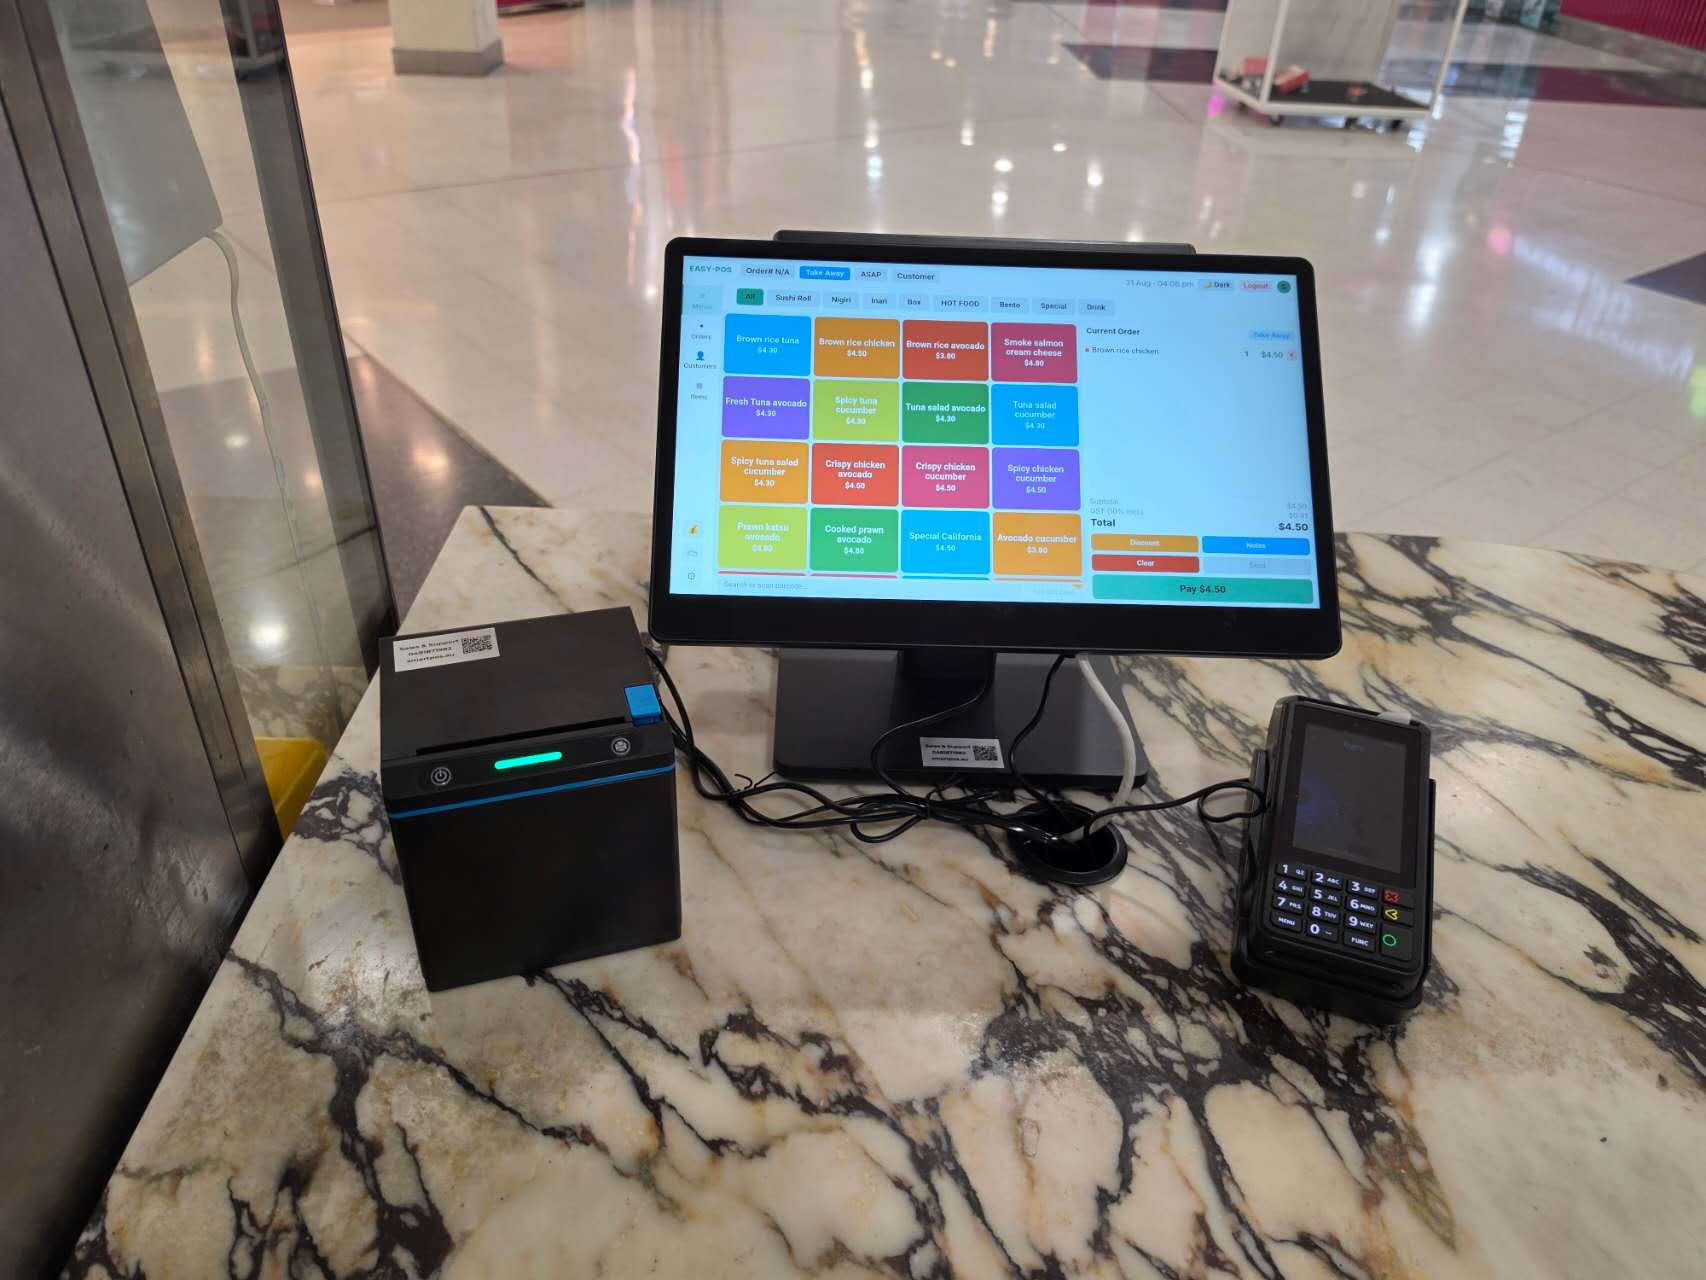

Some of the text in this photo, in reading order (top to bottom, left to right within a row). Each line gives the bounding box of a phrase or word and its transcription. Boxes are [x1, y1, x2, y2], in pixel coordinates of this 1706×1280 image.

[689, 265, 733, 273] EASY-POS
[746, 266, 791, 276] Order# N/A
[824, 271, 845, 279] Away
[897, 272, 935, 280] Customer
[776, 294, 796, 302] Sushi
[832, 296, 852, 304] Nigiri
[872, 297, 888, 305] Inari
[1000, 301, 1021, 309] Bento
[1040, 302, 1067, 311] Special
[1118, 328, 1141, 336] Order
[736, 335, 800, 345] Brown rice tuna
[818, 337, 896, 347] Brown rice chicken
[906, 340, 984, 350] Brown rice avocado
[1004, 338, 1064, 348] Smoke salmon
[1033, 348, 1062, 357] cheese
[726, 396, 807, 408] Fresh Tuna avocado
[834, 396, 858, 406] Spicy
[1012, 400, 1033, 409] Tuna
[836, 406, 877, 414] cucumber
[906, 402, 986, 413] Tuna salad avocado
[1014, 410, 1056, 418] cucumber
[730, 456, 799, 466] Spicy tuna salad
[825, 460, 886, 470] Crispy chicken
[744, 467, 785, 476] cucumber
[916, 462, 976, 472] Crispy chicken
[1008, 464, 1064, 474] Spicy chicken
[838, 471, 873, 479] avocado
[924, 472, 966, 481] cucumber
[1016, 475, 1057, 483] cucumber
[736, 522, 764, 531] Prawn
[1090, 518, 1116, 527] Total
[1278, 522, 1308, 532] $4.50
[824, 524, 884, 535] Cooked prawn
[836, 536, 872, 544] avocado
[910, 532, 982, 542] Special California
[998, 534, 1078, 543] Avocado cucumber
[1136, 559, 1156, 567] Clear
[1180, 584, 1226, 594] Pay $4.50
[1282, 864, 1288, 874] 1
[1316, 872, 1340, 885] 2 ABC
[1278, 880, 1288, 891] 4
[1352, 881, 1376, 894] 3 DEF
[1314, 889, 1322, 900] 5
[1277, 896, 1286, 907] 7
[1350, 898, 1376, 912] 6 MNO
[1312, 906, 1337, 919] 8 TUV
[1278, 917, 1296, 926] MENU
[1348, 916, 1358, 927] 9
[1310, 924, 1320, 934] 0
[1351, 937, 1369, 946] FUNC
